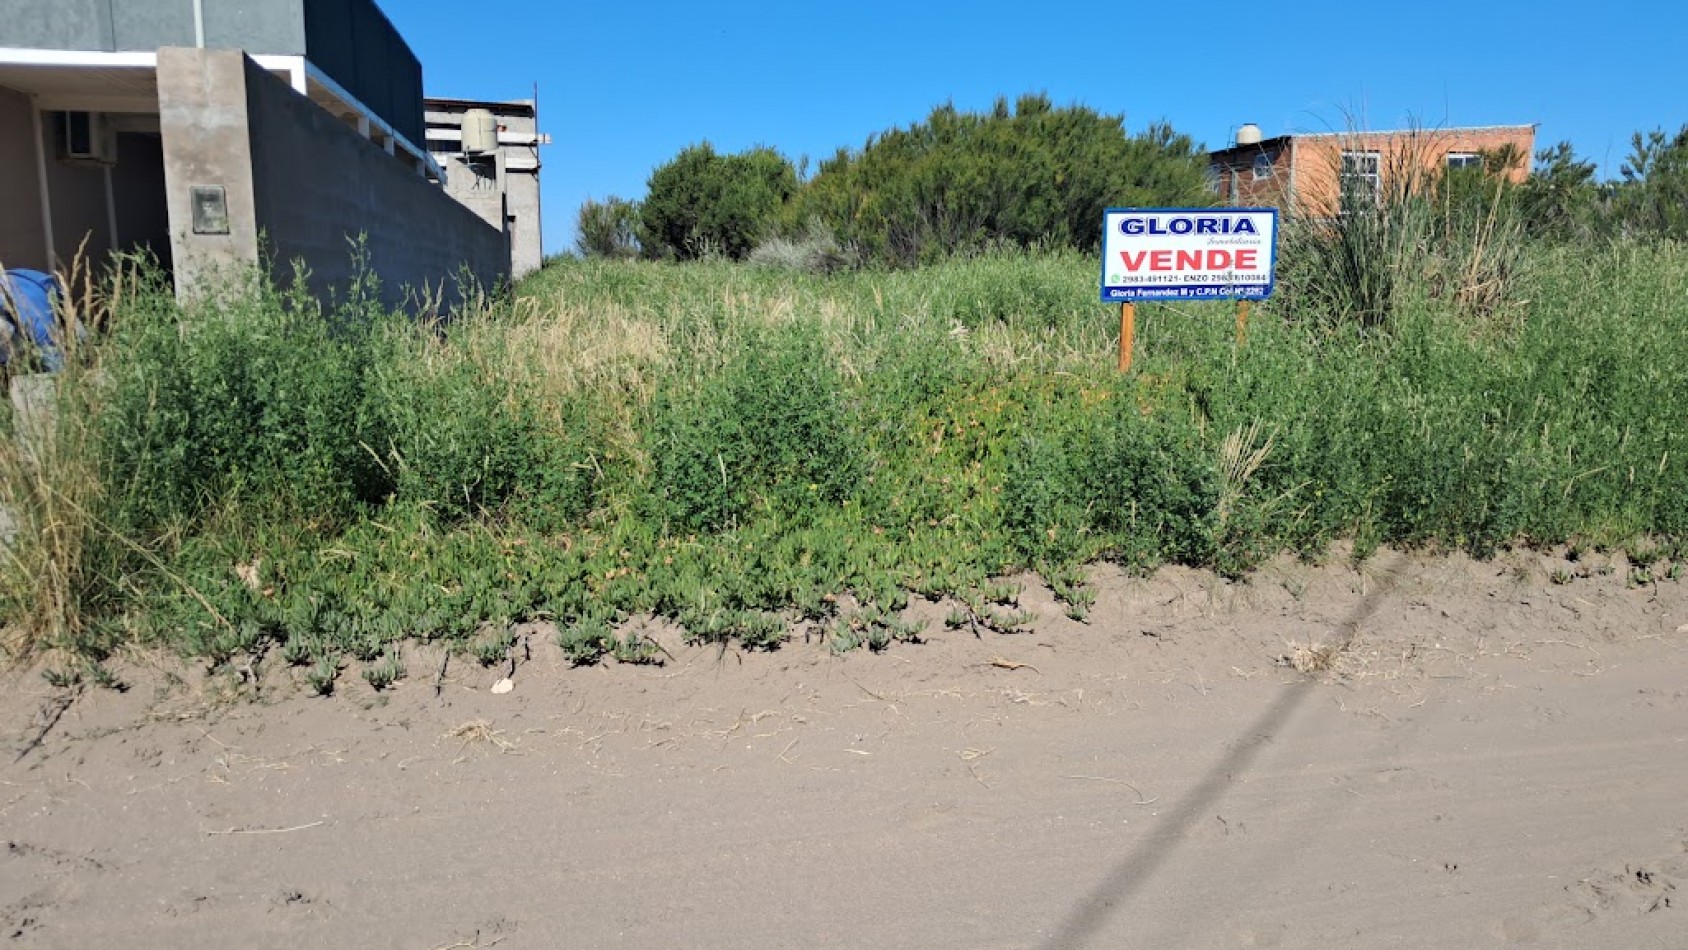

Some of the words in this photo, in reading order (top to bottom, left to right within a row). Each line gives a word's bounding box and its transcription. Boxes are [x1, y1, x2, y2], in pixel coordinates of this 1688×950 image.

[1119, 216, 1259, 236] GLORIA
[1119, 249, 1258, 272] VENDE
[1183, 275, 1208, 283] ENZO
[1110, 288, 1136, 297] Gloria
[1137, 287, 1180, 297] Fernandez
